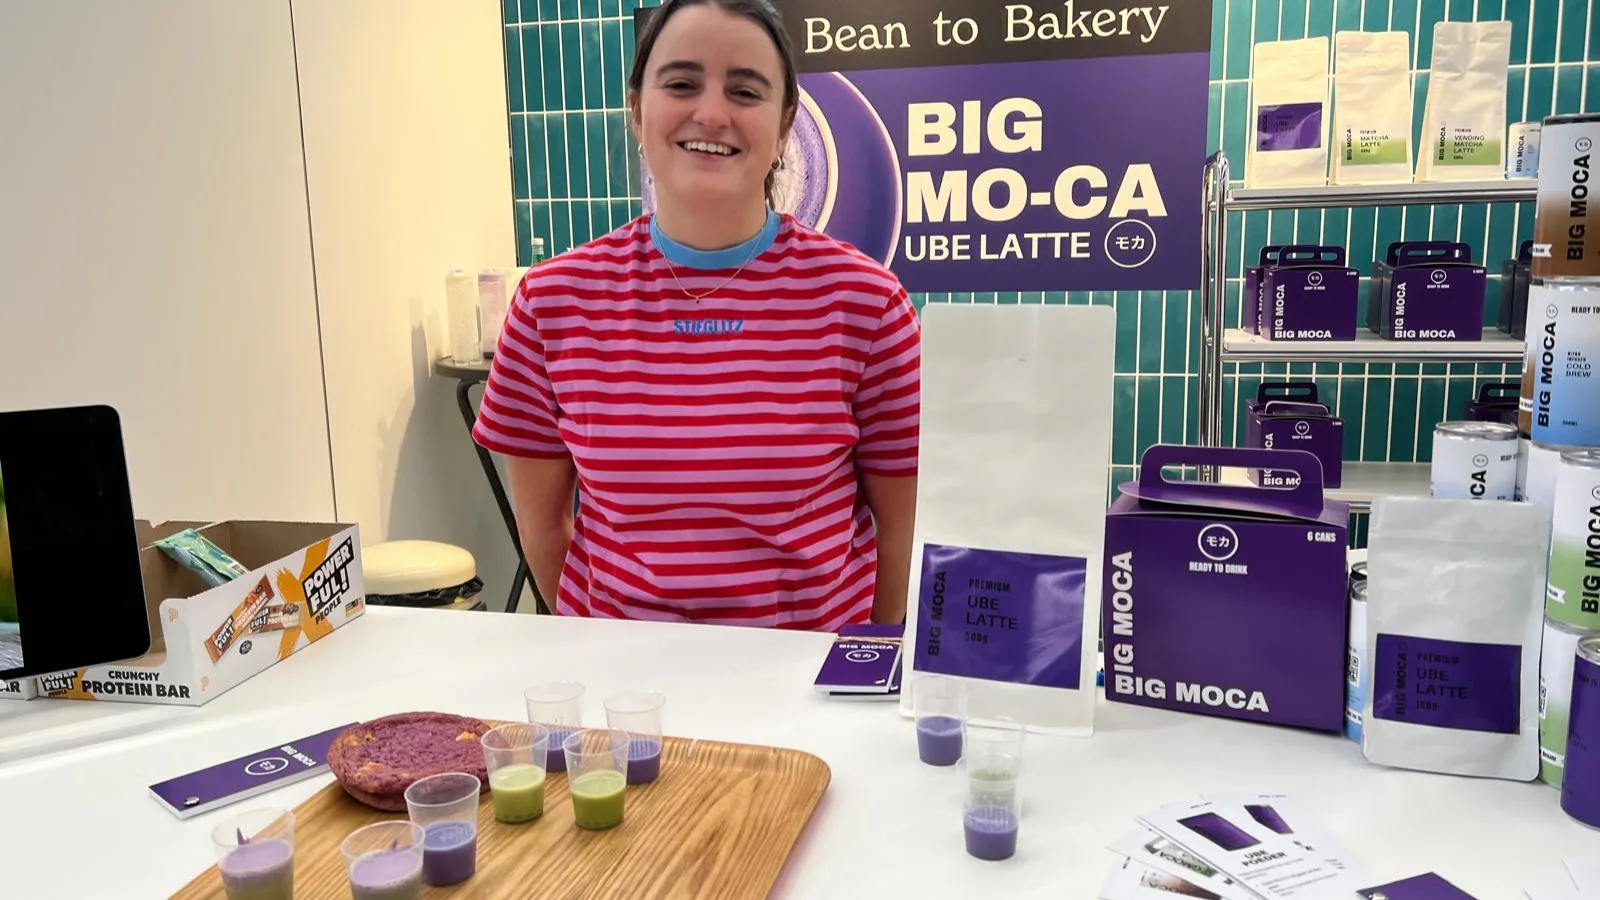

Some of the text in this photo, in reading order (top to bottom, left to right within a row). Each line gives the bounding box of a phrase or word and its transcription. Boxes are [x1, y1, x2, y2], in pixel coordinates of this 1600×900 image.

[804, 0, 1169, 54] Bean to Bakery
[908, 98, 1043, 156] BIG
[906, 163, 1168, 224] MO-CA
[1570, 154, 1590, 218] MOCA
[904, 232, 1090, 261] UBE LATTE
[1115, 236, 1145, 250] モカ
[1567, 224, 1585, 261] BIG
[1276, 284, 1285, 316] MOCA
[1396, 282, 1406, 316] MOCA
[1572, 306, 1590, 314] READY
[674, 319, 744, 334] STIEGLITZ
[1274, 330, 1332, 338] BIG MOCA
[1394, 330, 1456, 338] BIG MOCA
[1540, 322, 1556, 384] MOCA
[1566, 370, 1592, 378] BREW
[1538, 391, 1551, 427] BIG
[1470, 470, 1486, 500] CA
[1206, 536, 1230, 548] モカ
[1307, 532, 1336, 542] 6 CANS
[304, 544, 351, 598] POWER
[1189, 562, 1248, 574] READY TO DRINK
[1581, 505, 1600, 614] BIG MOCA
[310, 567, 348, 613] FUL!
[968, 578, 1010, 592] PREMIUM
[1112, 551, 1134, 636] MOCA
[316, 595, 342, 625] PEOPLE
[928, 570, 946, 656] BIG MOCA
[968, 596, 1000, 611] UBE
[966, 612, 1018, 630] LATTE
[82, 680, 190, 698] PROTEIN BAR
[108, 670, 160, 682] CRUNCHY
[1396, 652, 1408, 714] BIG MOCA
[1416, 668, 1449, 682] UBE
[1115, 674, 1270, 712] BIG MOCA
[1416, 683, 1468, 698] LATTE
